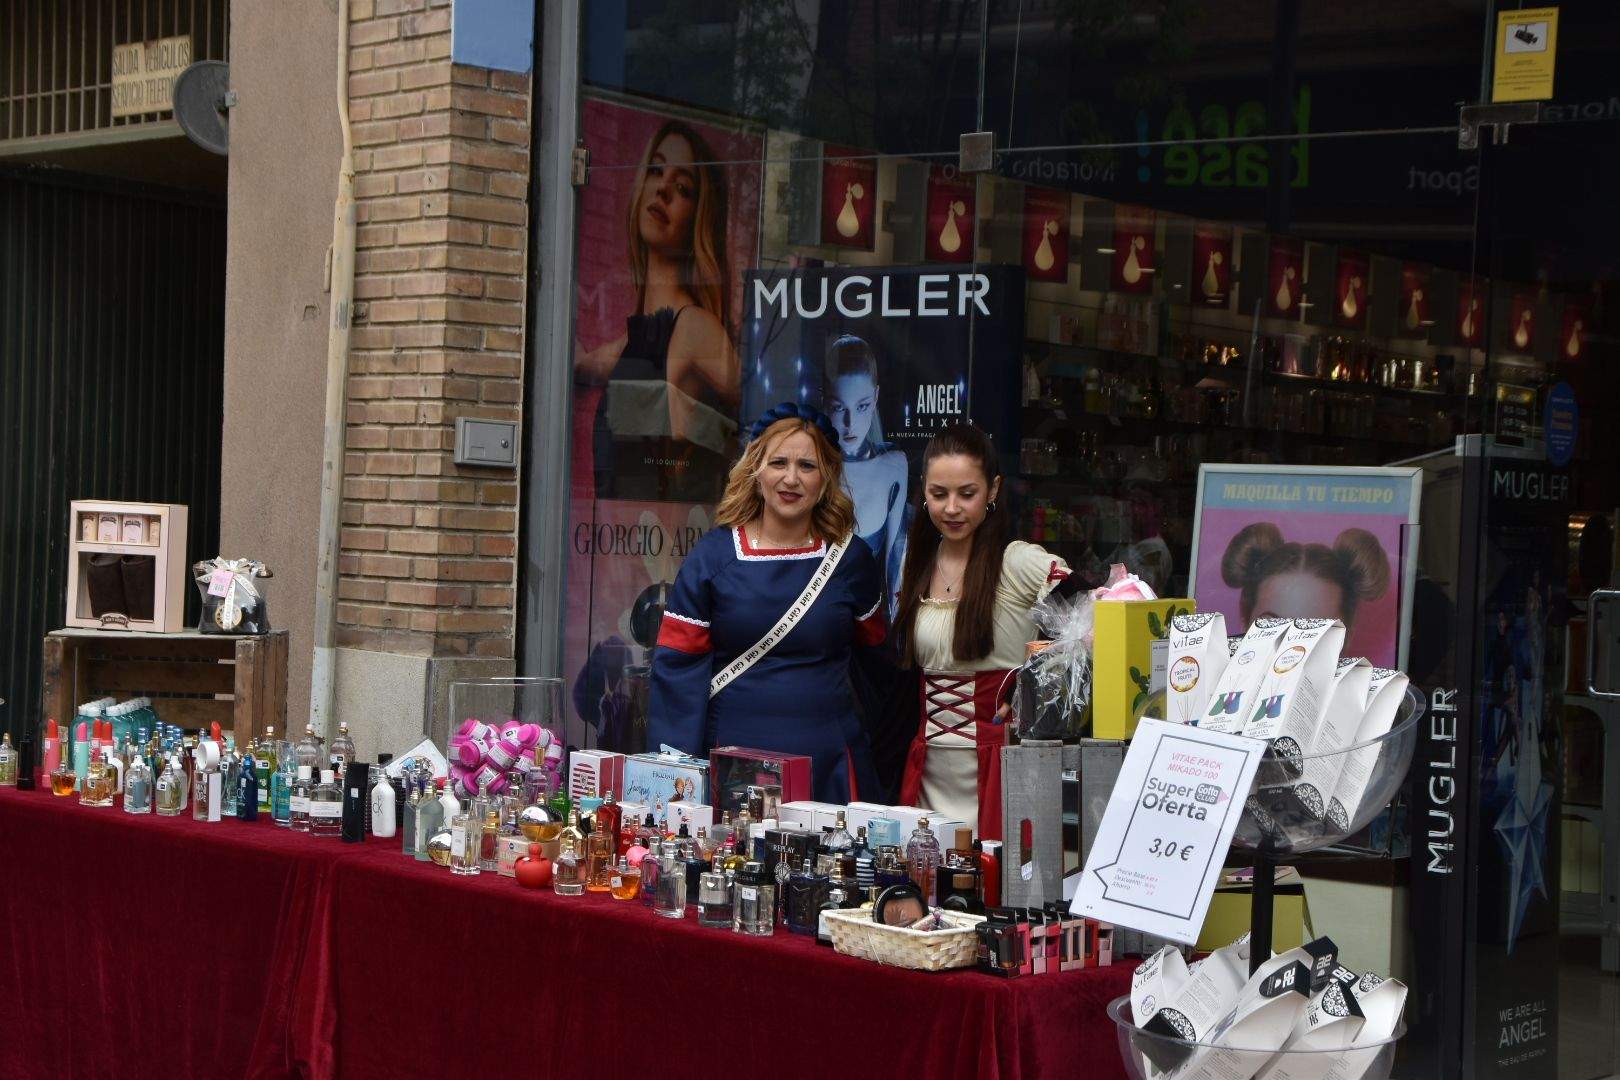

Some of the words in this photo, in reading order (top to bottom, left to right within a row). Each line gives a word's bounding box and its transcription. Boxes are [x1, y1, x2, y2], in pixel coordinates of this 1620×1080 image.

[113, 48, 139, 76] SALIDA
[753, 273, 992, 321] MUGLER
[916, 384, 962, 414] ANGEL
[1222, 483, 1300, 501] MAQUILLA
[1331, 487, 1394, 504] TIEMPO
[574, 522, 664, 557] GIORGIO
[1173, 635, 1204, 649] vitae
[1247, 629, 1278, 640] vitae
[1287, 631, 1319, 642] vitae
[1167, 763, 1202, 776] MIKADO
[1171, 752, 1199, 765] VITAE
[1197, 758, 1223, 770] PACK
[1147, 777, 1194, 799] Super
[1427, 686, 1458, 874] MUGLER
[372, 797, 384, 816] ck
[1142, 792, 1208, 821] Oferta
[773, 844, 796, 854] REPLAY
[1149, 838, 1178, 858] 3,0
[1180, 845, 1195, 861] €
[1134, 966, 1159, 989] vitae
[1499, 1008, 1513, 1023] WE
[1515, 1003, 1532, 1018] ARE
[1499, 1016, 1547, 1049] ANGEL
